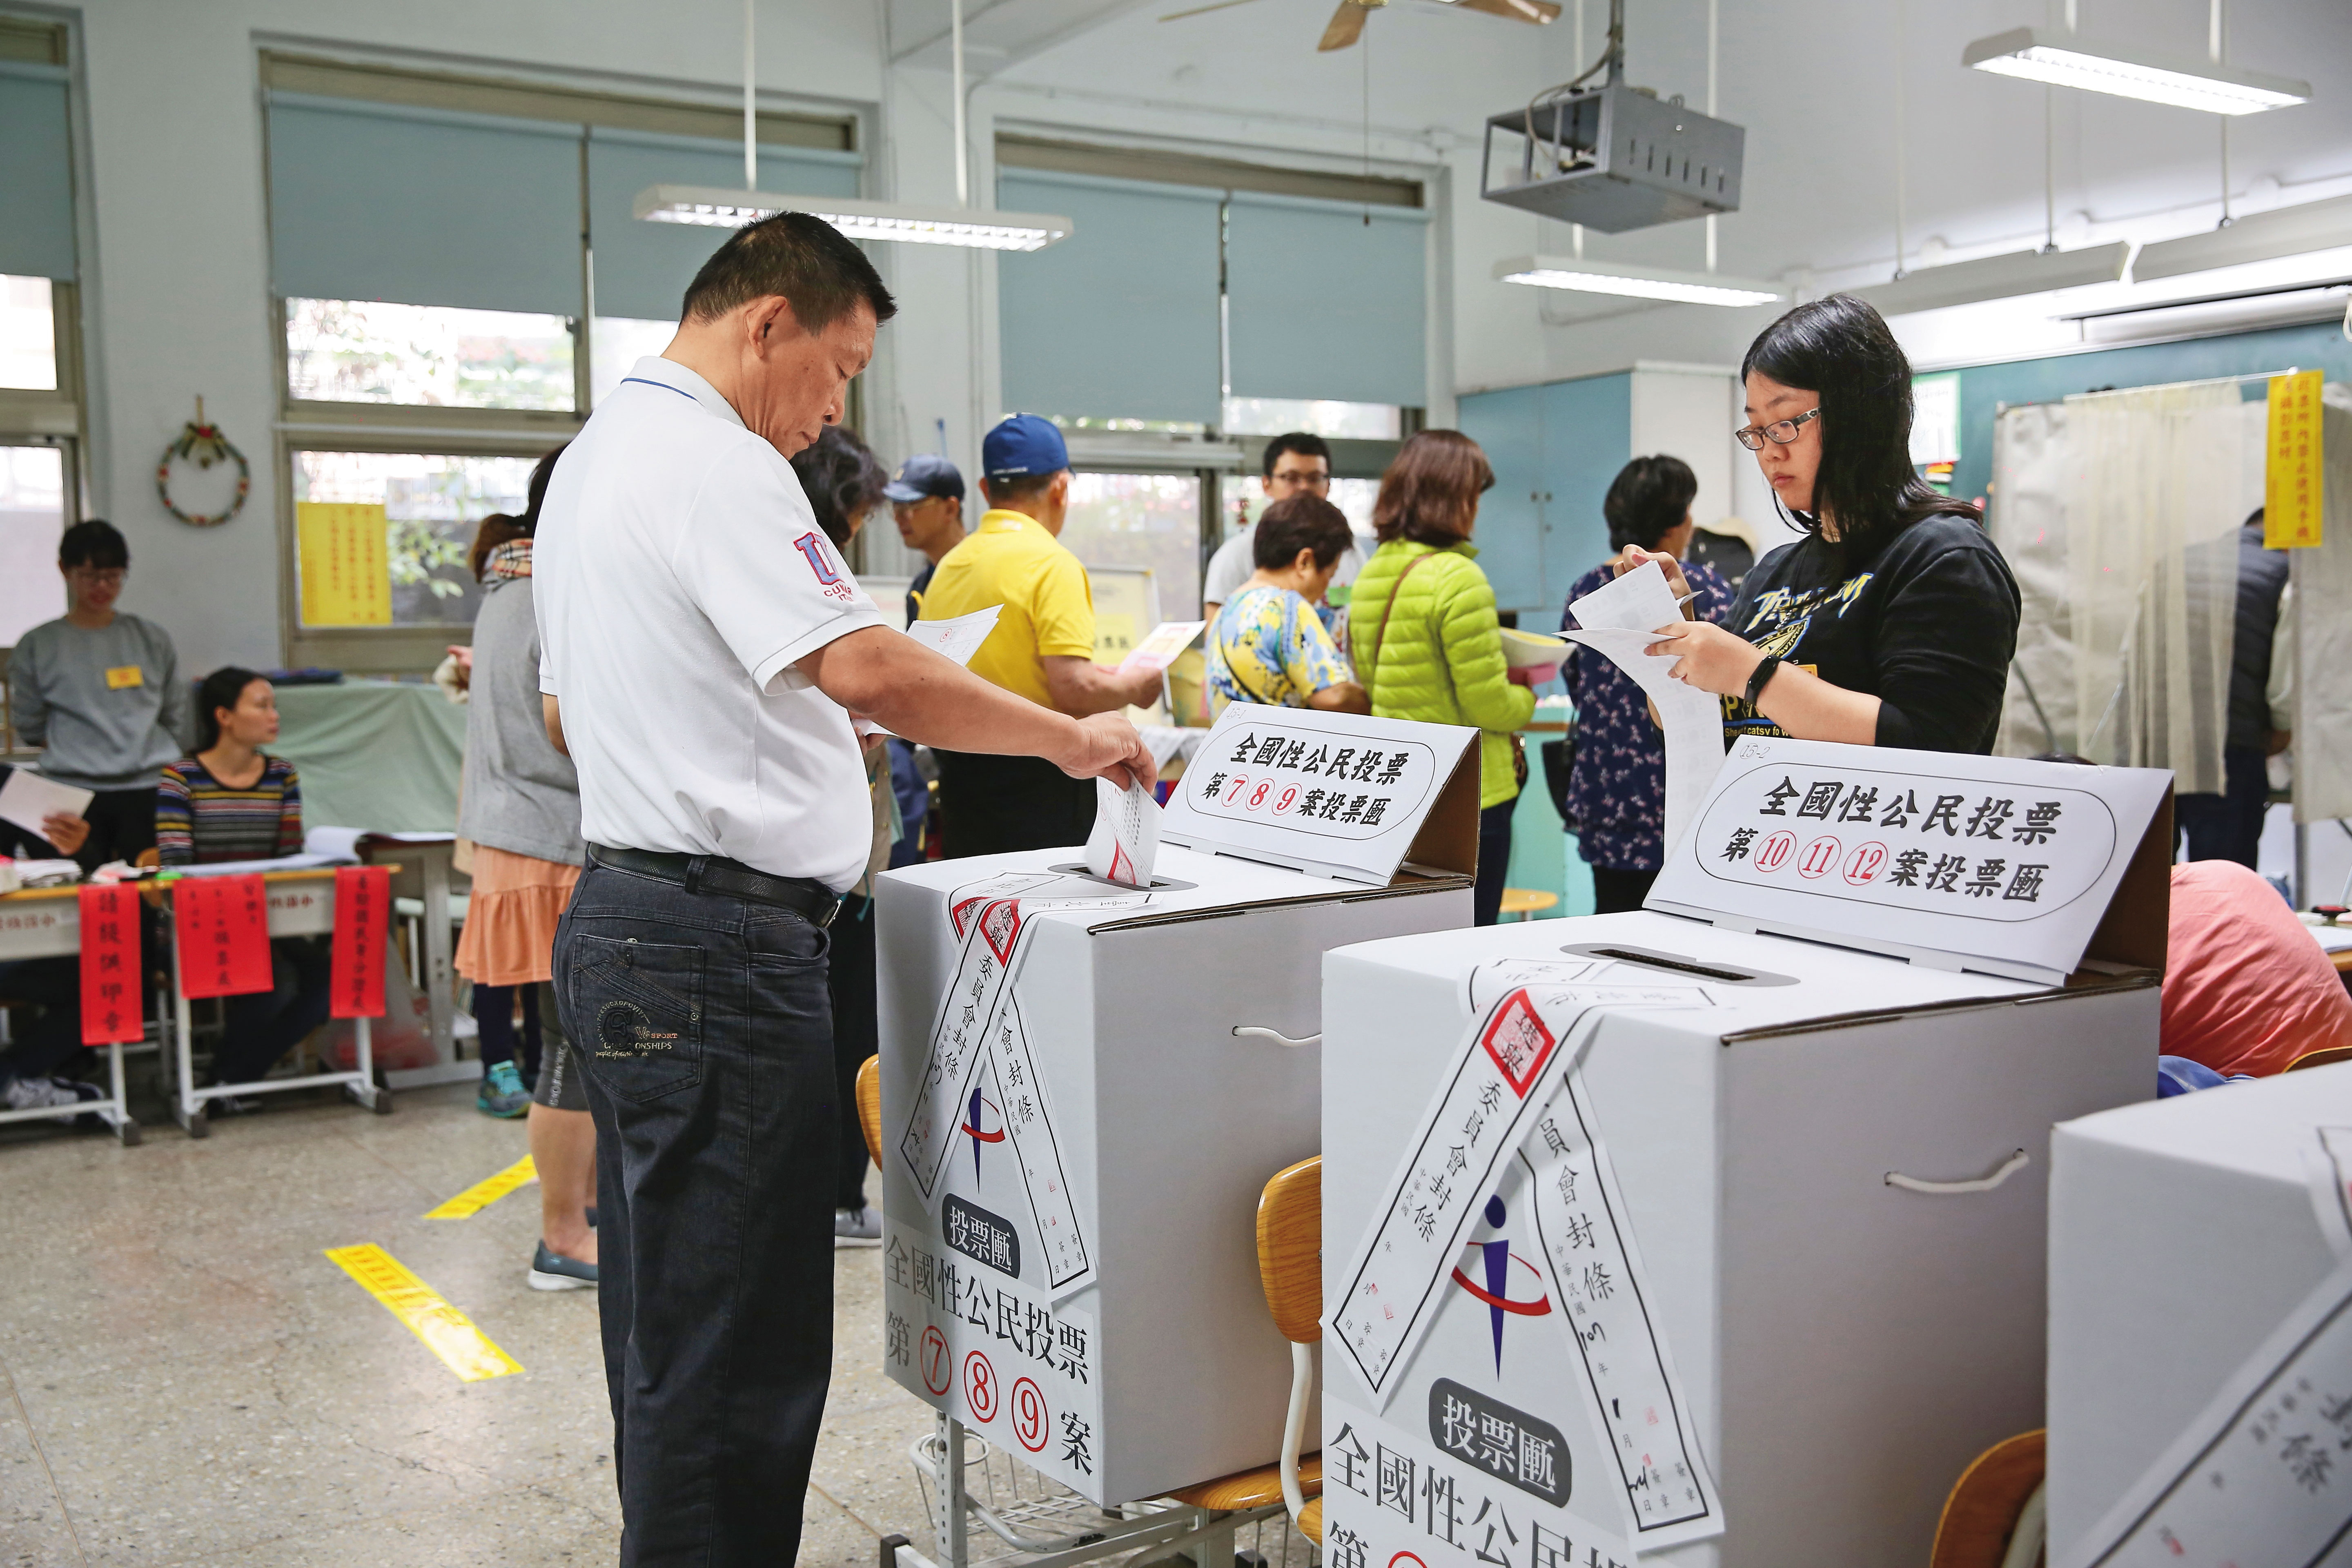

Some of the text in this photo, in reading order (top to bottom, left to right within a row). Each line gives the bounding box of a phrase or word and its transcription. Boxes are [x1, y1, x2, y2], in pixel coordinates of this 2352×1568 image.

[1230, 732, 1409, 785] 全國性公民投票
[1759, 775, 2062, 846] 全國性公民投票
[998, 1007, 1034, 1125] 會封條
[1004, 1083, 1021, 1136] 中華民國
[1042, 1218, 1048, 1230] 月
[1055, 1264, 1060, 1275] 日
[1539, 1103, 1615, 1301] 員會封條
[948, 1204, 1013, 1274] 投票匭
[884, 1232, 1089, 1385] 全國性公民投票
[1555, 1243, 1586, 1316] 中華民國
[1622, 1434, 1632, 1448] 月
[1644, 1499, 1651, 1511] 日
[1442, 1393, 1557, 1494] 投票匭
